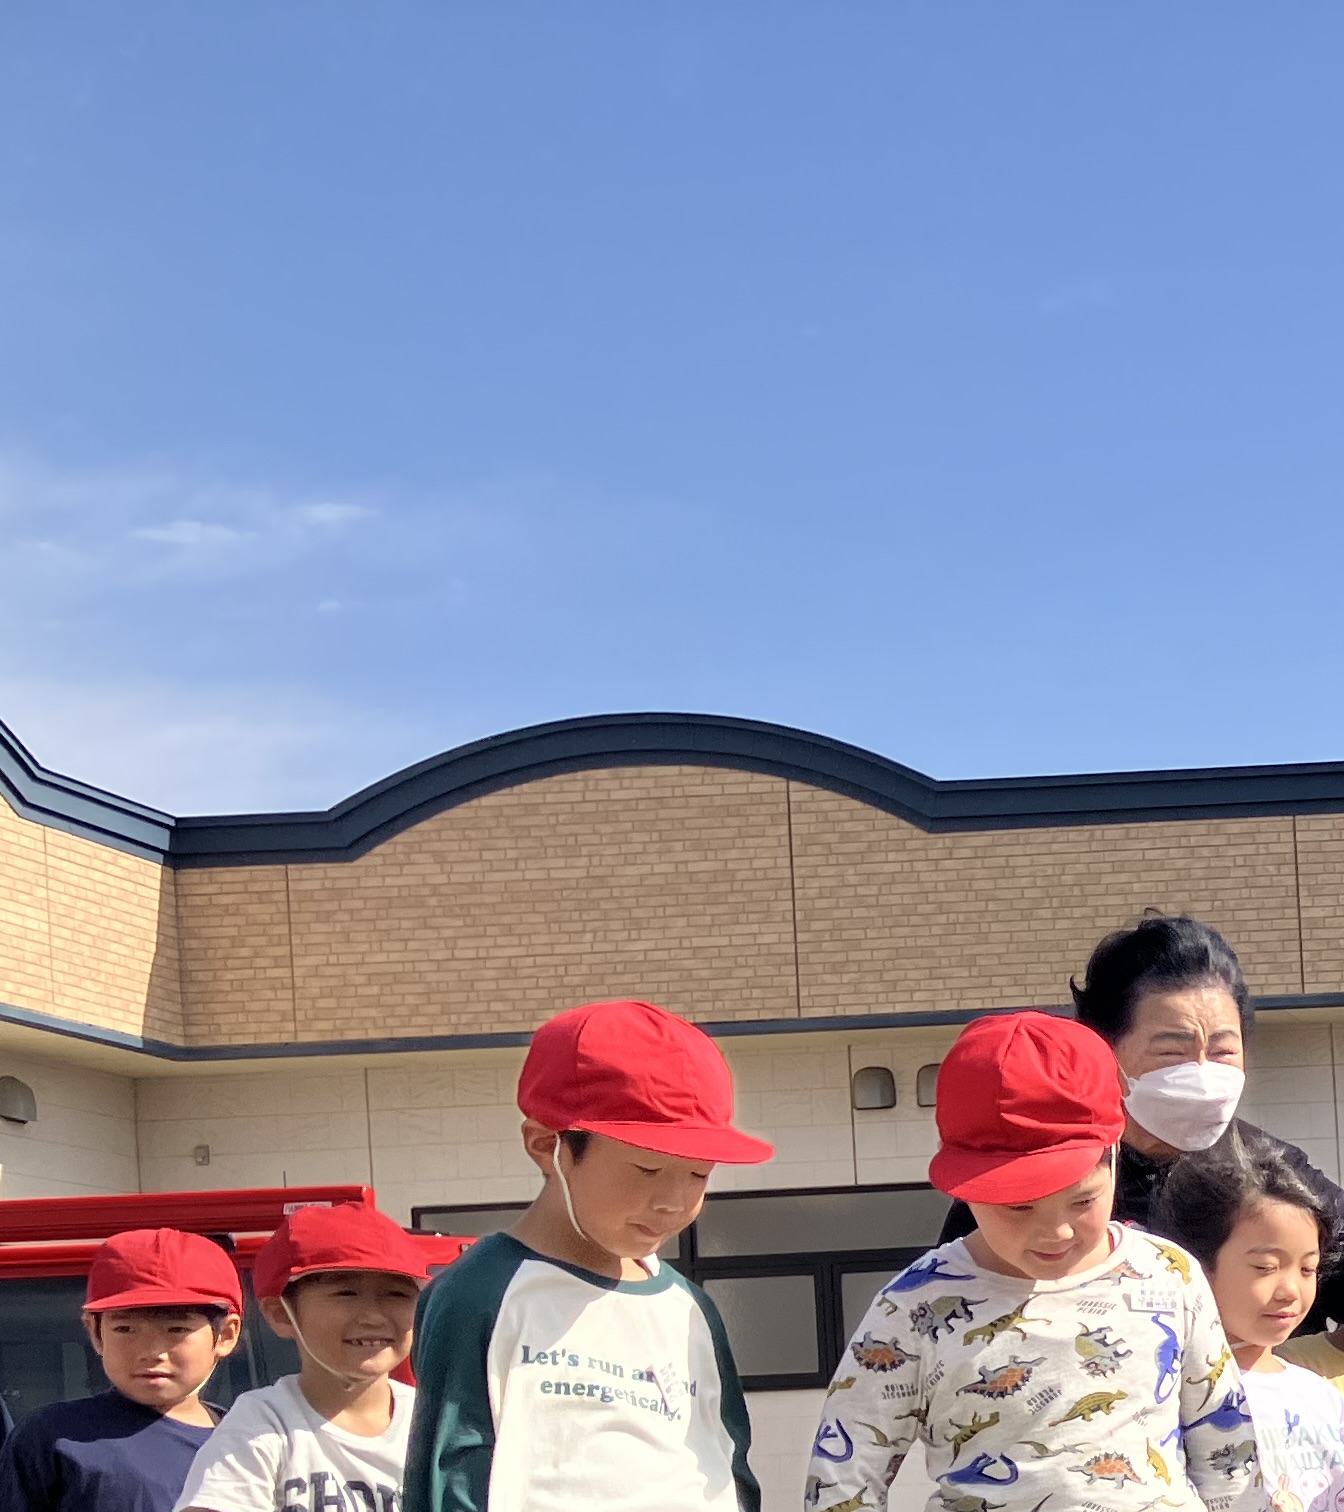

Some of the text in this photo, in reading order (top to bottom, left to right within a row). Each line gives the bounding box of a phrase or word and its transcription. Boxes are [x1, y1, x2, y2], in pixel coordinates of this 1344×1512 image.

[521, 1344, 580, 1368] Let's
[588, 1356, 625, 1379] run
[632, 1367, 697, 1397] ard
